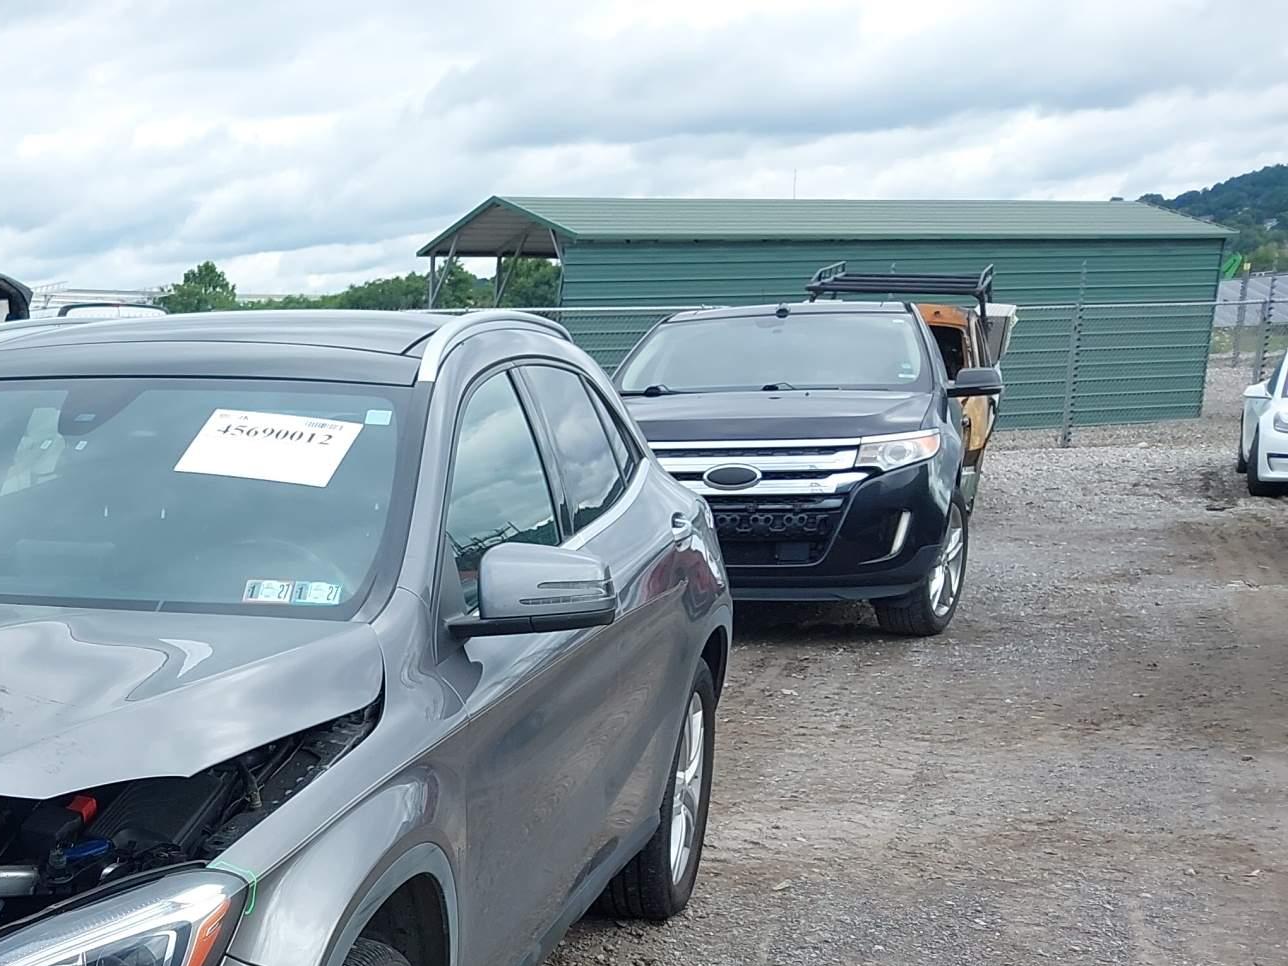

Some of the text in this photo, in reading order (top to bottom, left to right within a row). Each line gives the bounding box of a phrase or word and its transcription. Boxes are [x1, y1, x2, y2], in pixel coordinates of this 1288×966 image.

[217, 424, 333, 446] 45690012
[277, 584, 290, 600] 27
[326, 586, 339, 600] 27
